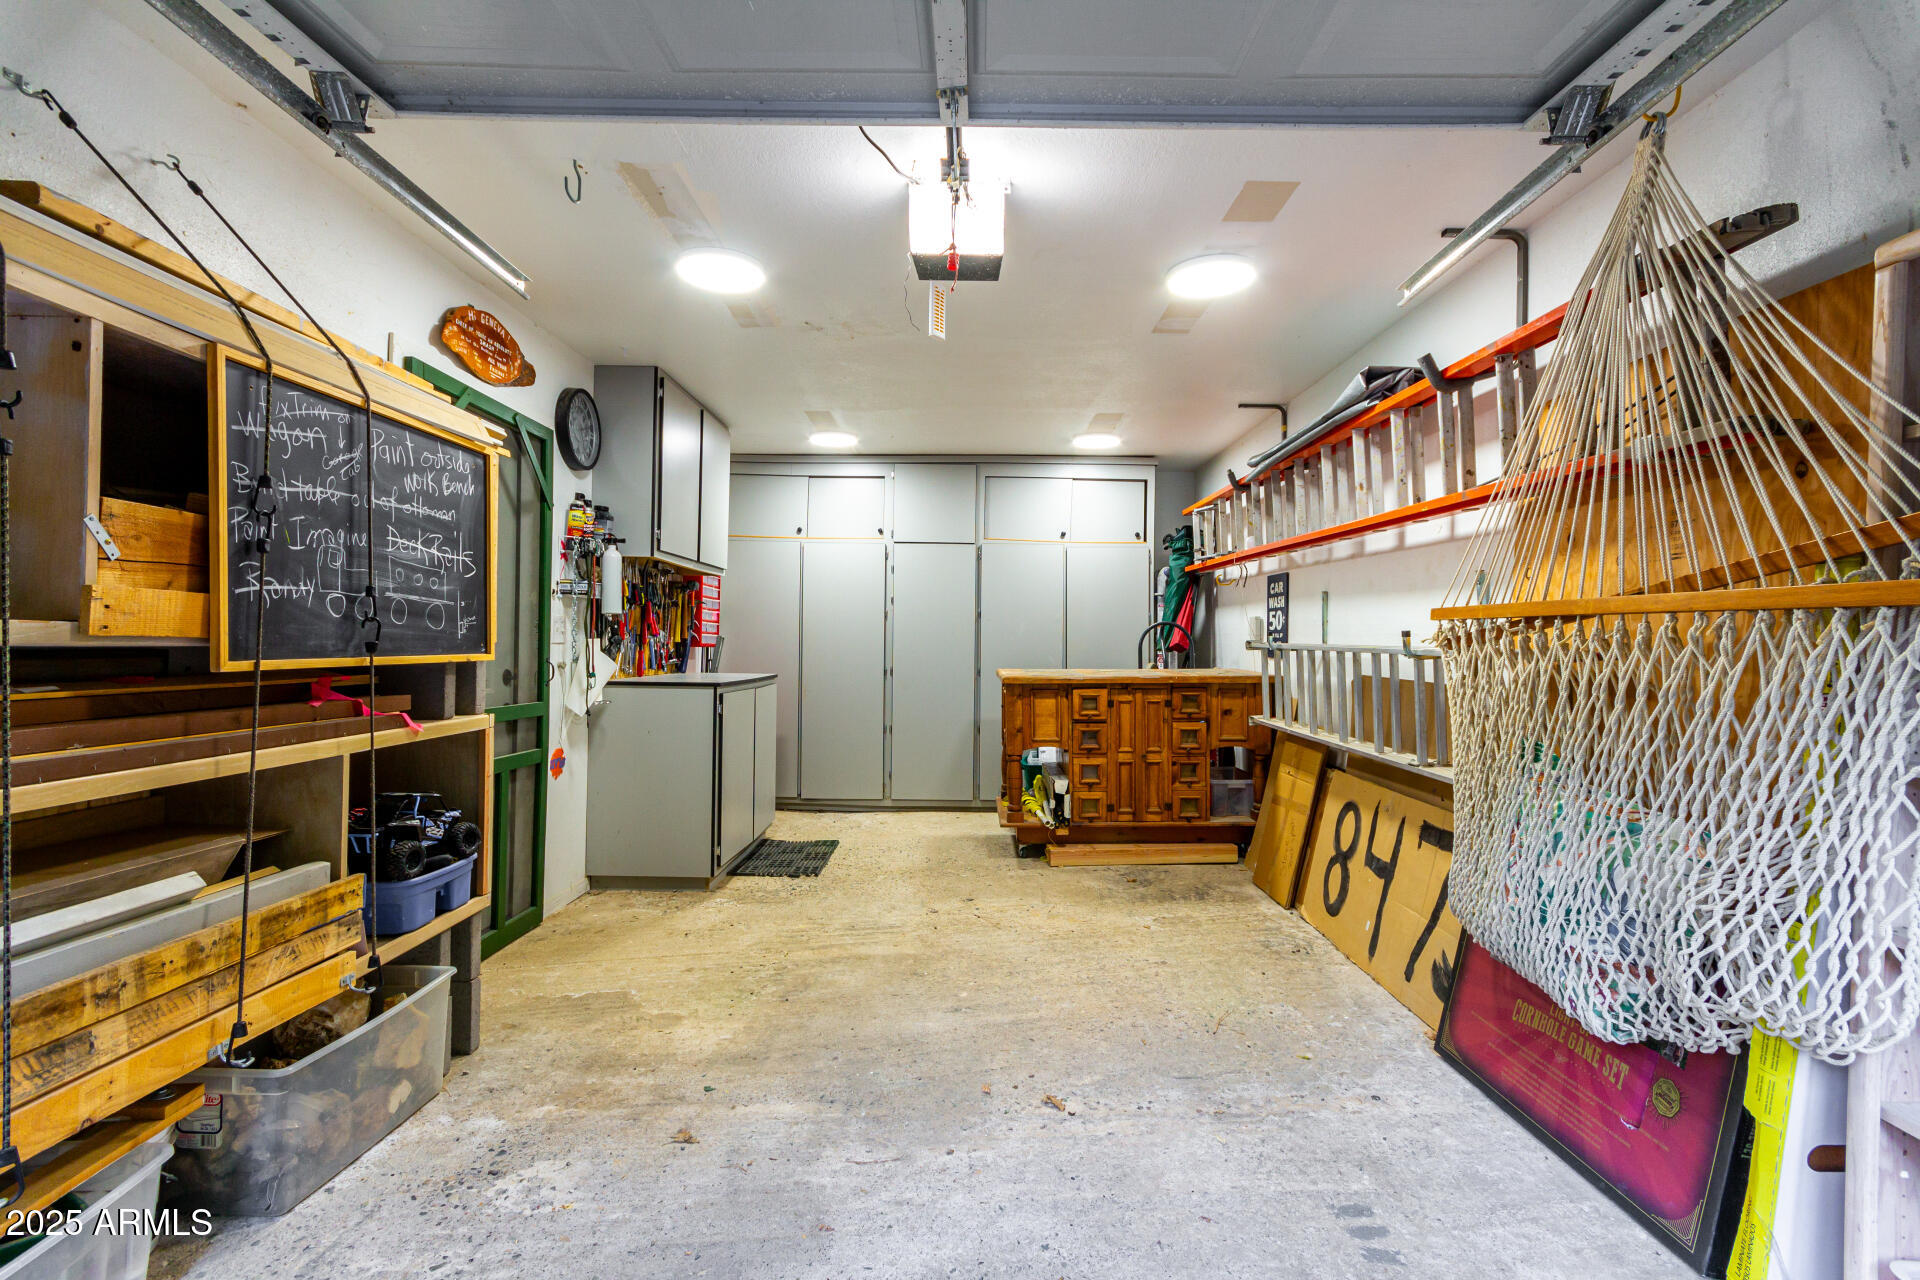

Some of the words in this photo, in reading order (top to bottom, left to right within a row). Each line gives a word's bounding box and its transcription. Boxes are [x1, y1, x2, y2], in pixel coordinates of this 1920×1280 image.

[371, 428, 415, 468] Paint
[1268, 596, 1285, 609] WASH
[1270, 581, 1284, 594] CAR
[1323, 801, 1455, 1003] 847
[1512, 999, 1565, 1043] CORNHOLE
[1567, 1032, 1602, 1068] GAME
[1602, 1054, 1630, 1091] SET
